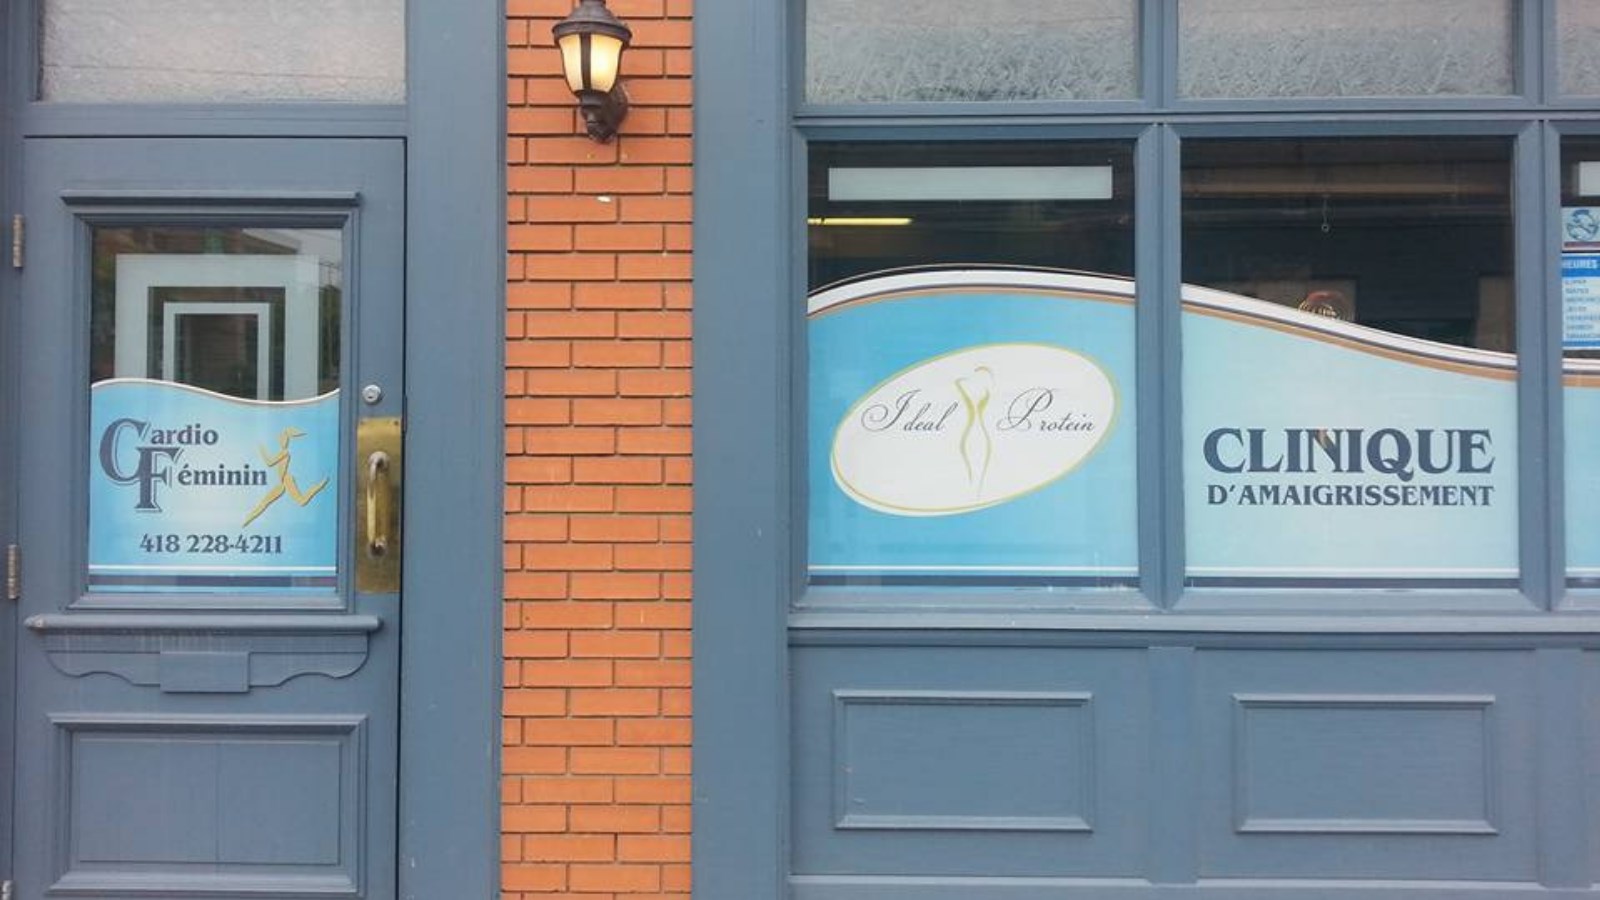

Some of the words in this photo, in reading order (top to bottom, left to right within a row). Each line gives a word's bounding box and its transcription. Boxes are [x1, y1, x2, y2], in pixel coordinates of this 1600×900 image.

[861, 389, 958, 432] Ideal
[996, 387, 1095, 432] Protein
[100, 417, 219, 487] Cardio
[1203, 427, 1495, 482] CLINIQUE
[134, 446, 268, 513] Féminin
[1207, 484, 1495, 506] D'AMAIGRISSEMENT
[140, 533, 181, 553] 418
[186, 533, 283, 555] 228-4211
